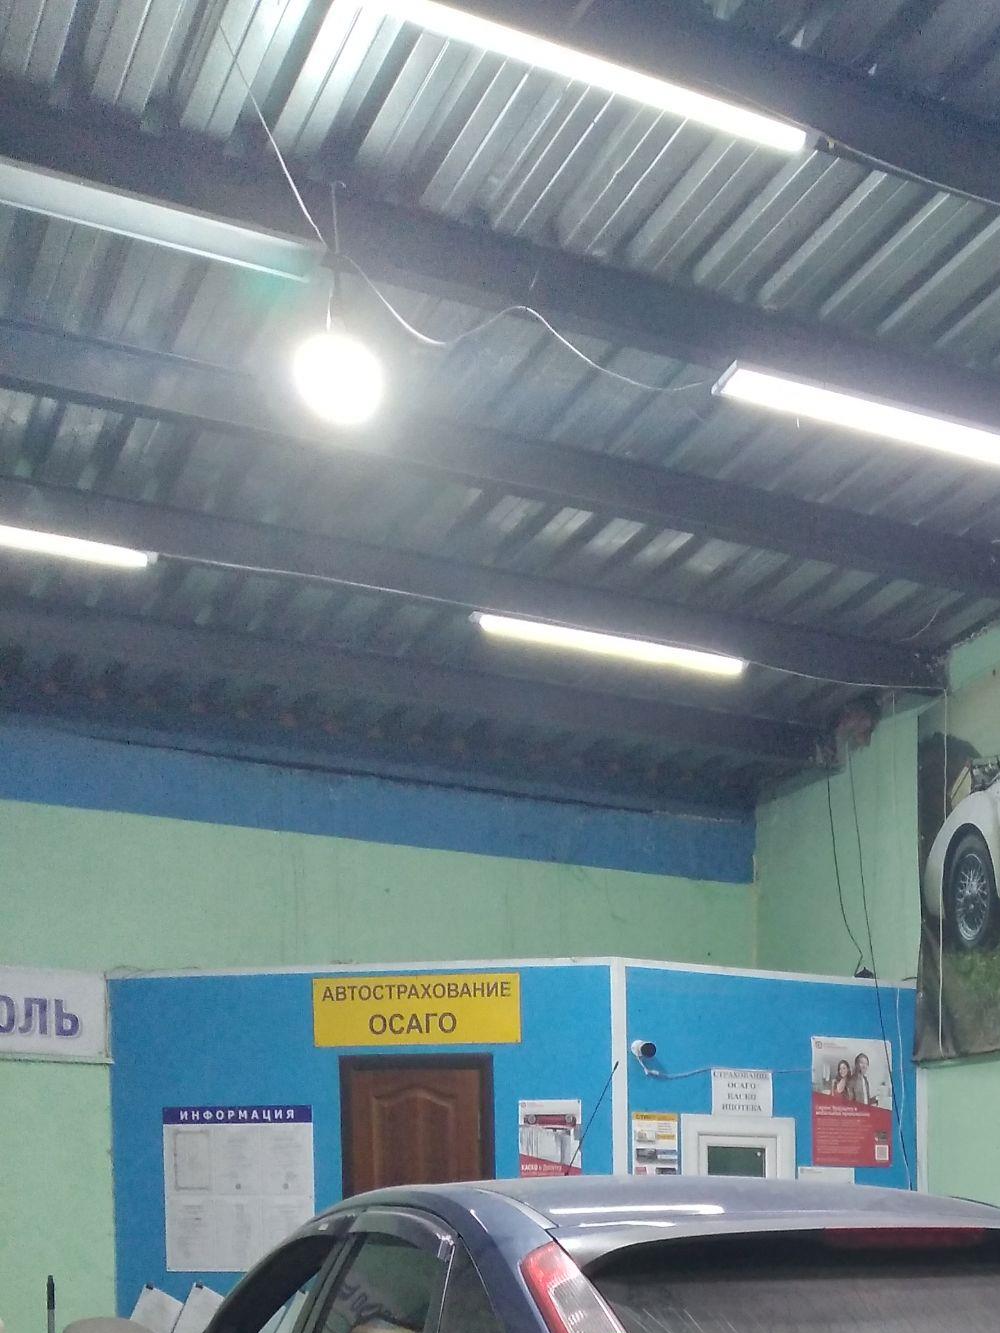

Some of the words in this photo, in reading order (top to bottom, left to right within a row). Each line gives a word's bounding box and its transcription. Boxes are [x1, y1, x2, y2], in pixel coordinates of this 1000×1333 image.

[322, 981, 511, 1001] АВТОСТРАХОВАНИЕ
[368, 1012, 457, 1035] ОСАГО
[179, 1109, 295, 1122] ИНФОРМАЦИЯ
